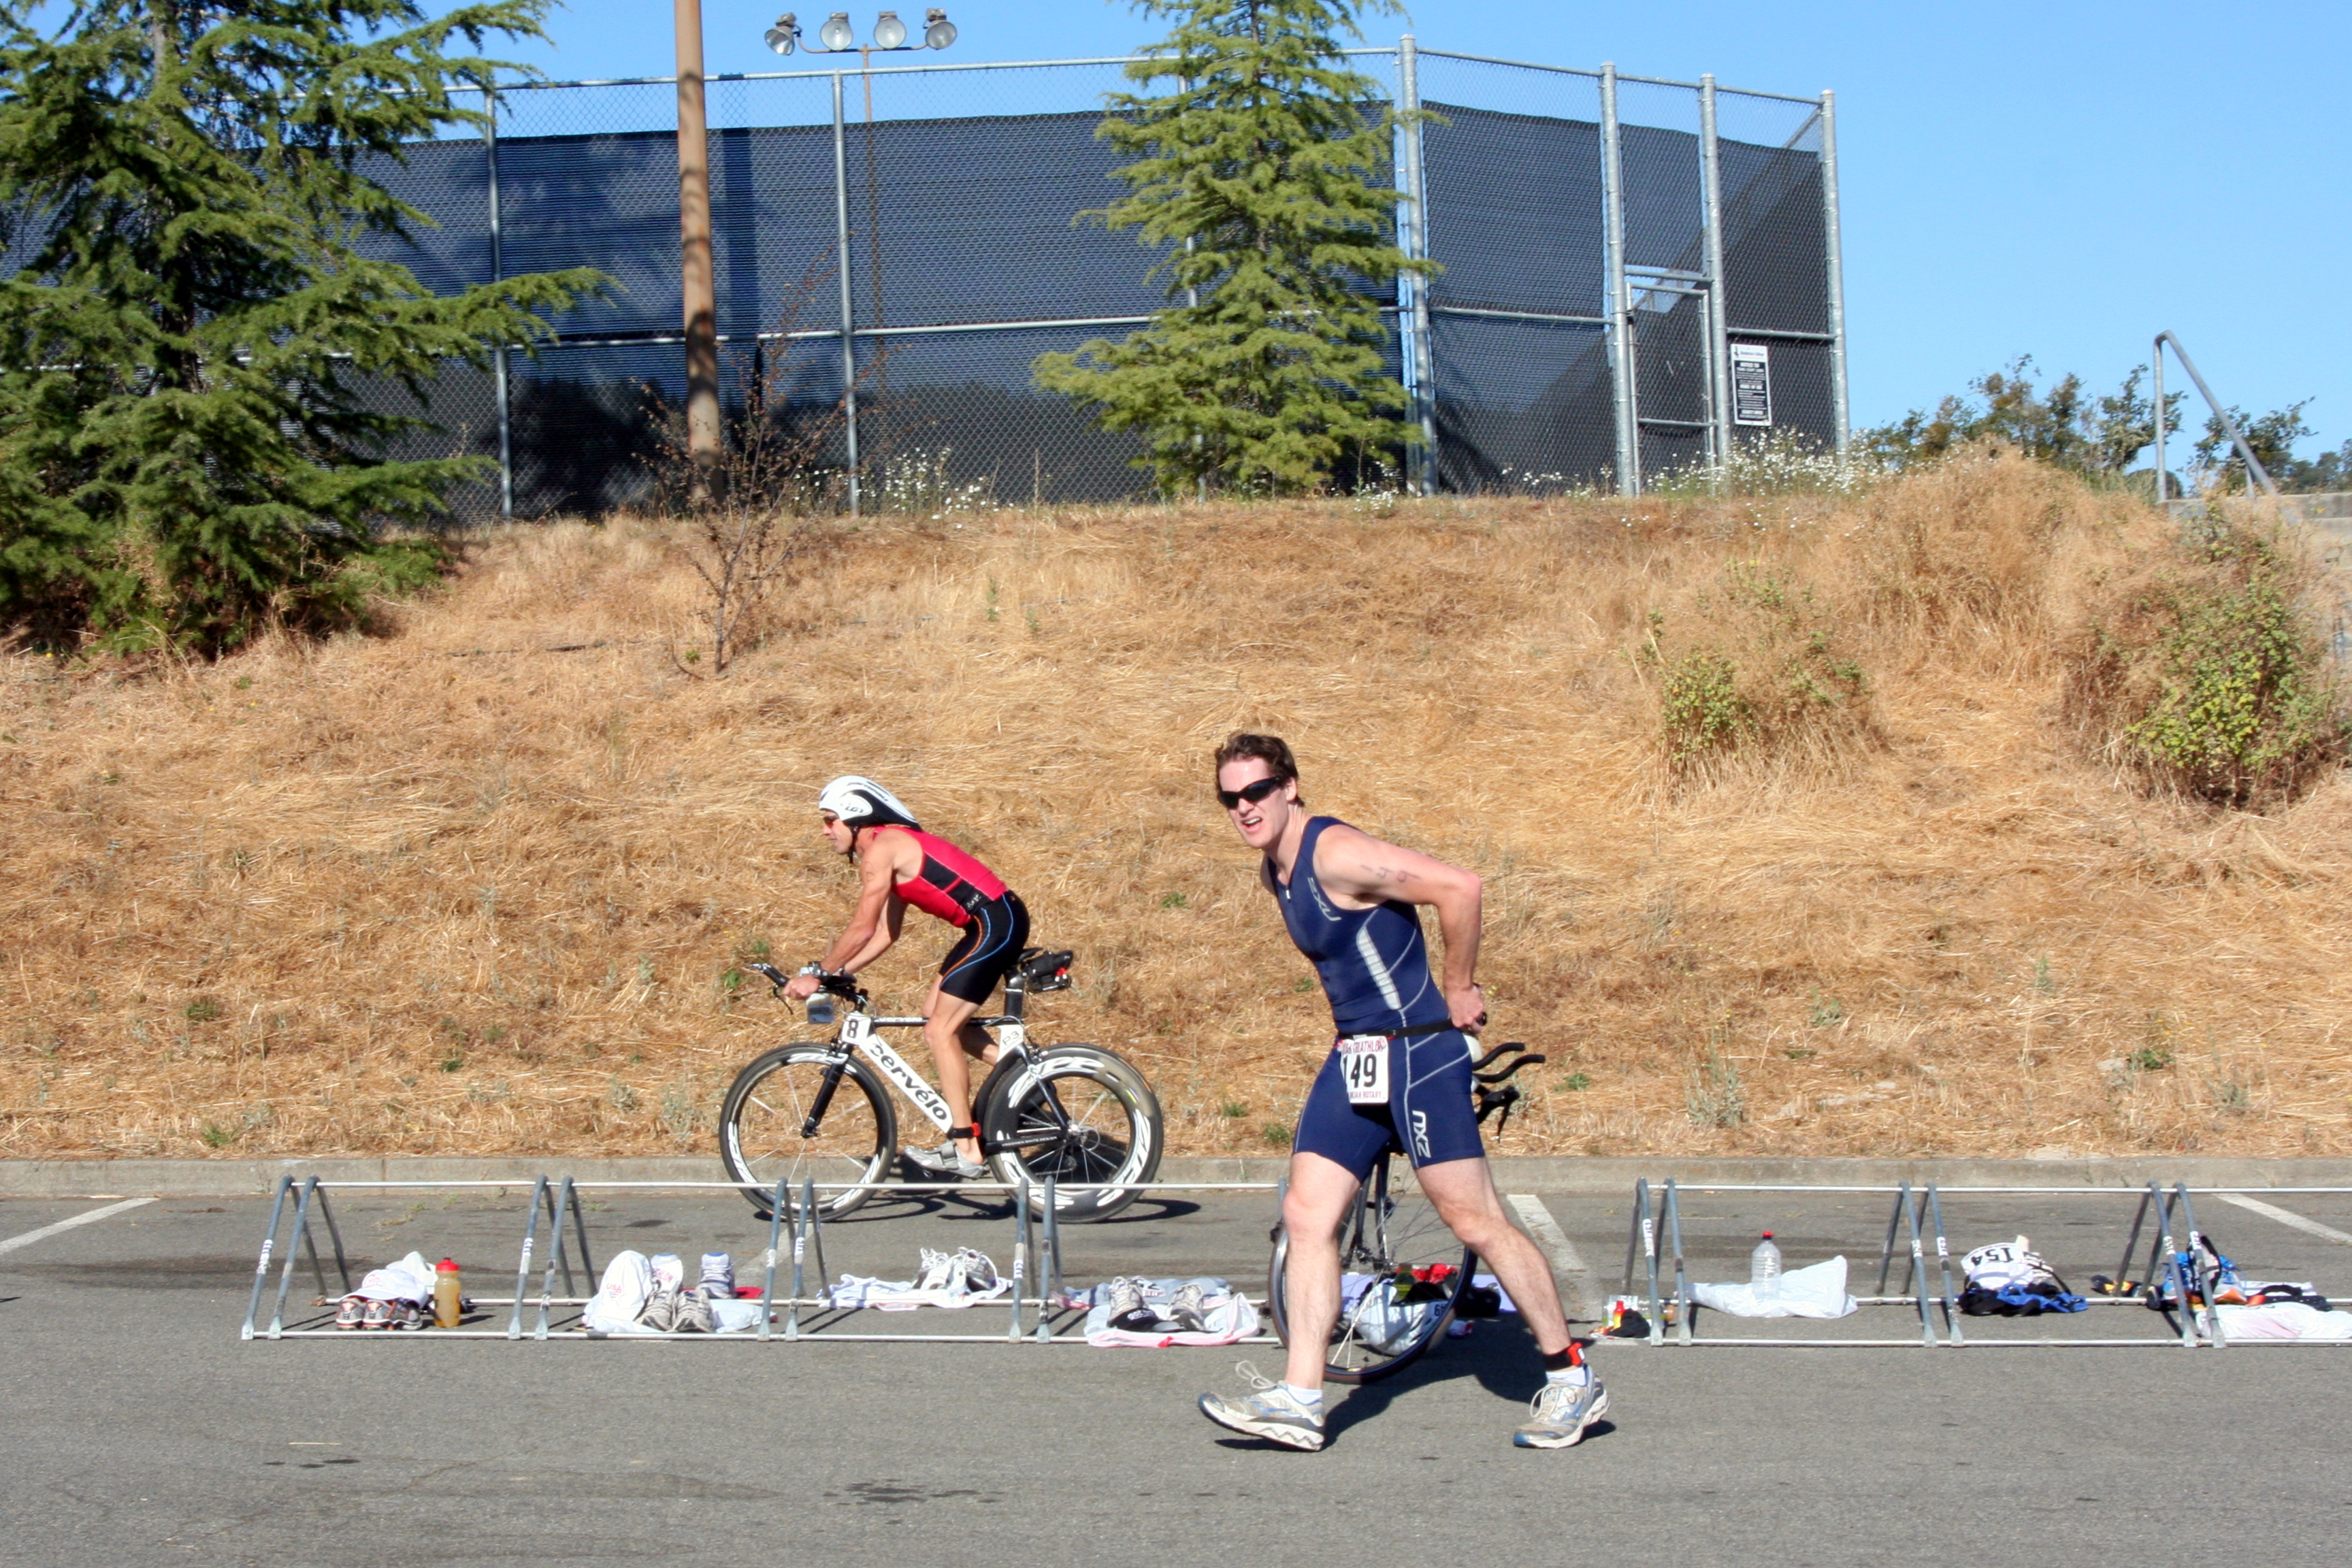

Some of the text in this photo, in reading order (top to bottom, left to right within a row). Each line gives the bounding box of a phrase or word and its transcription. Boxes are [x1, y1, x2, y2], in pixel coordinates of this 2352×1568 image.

[1002, 1030, 1020, 1046] P3
[1343, 1053, 1377, 1089] 149
[1411, 1109, 1432, 1158] 2XU
[1970, 1247, 2014, 1267] 154
